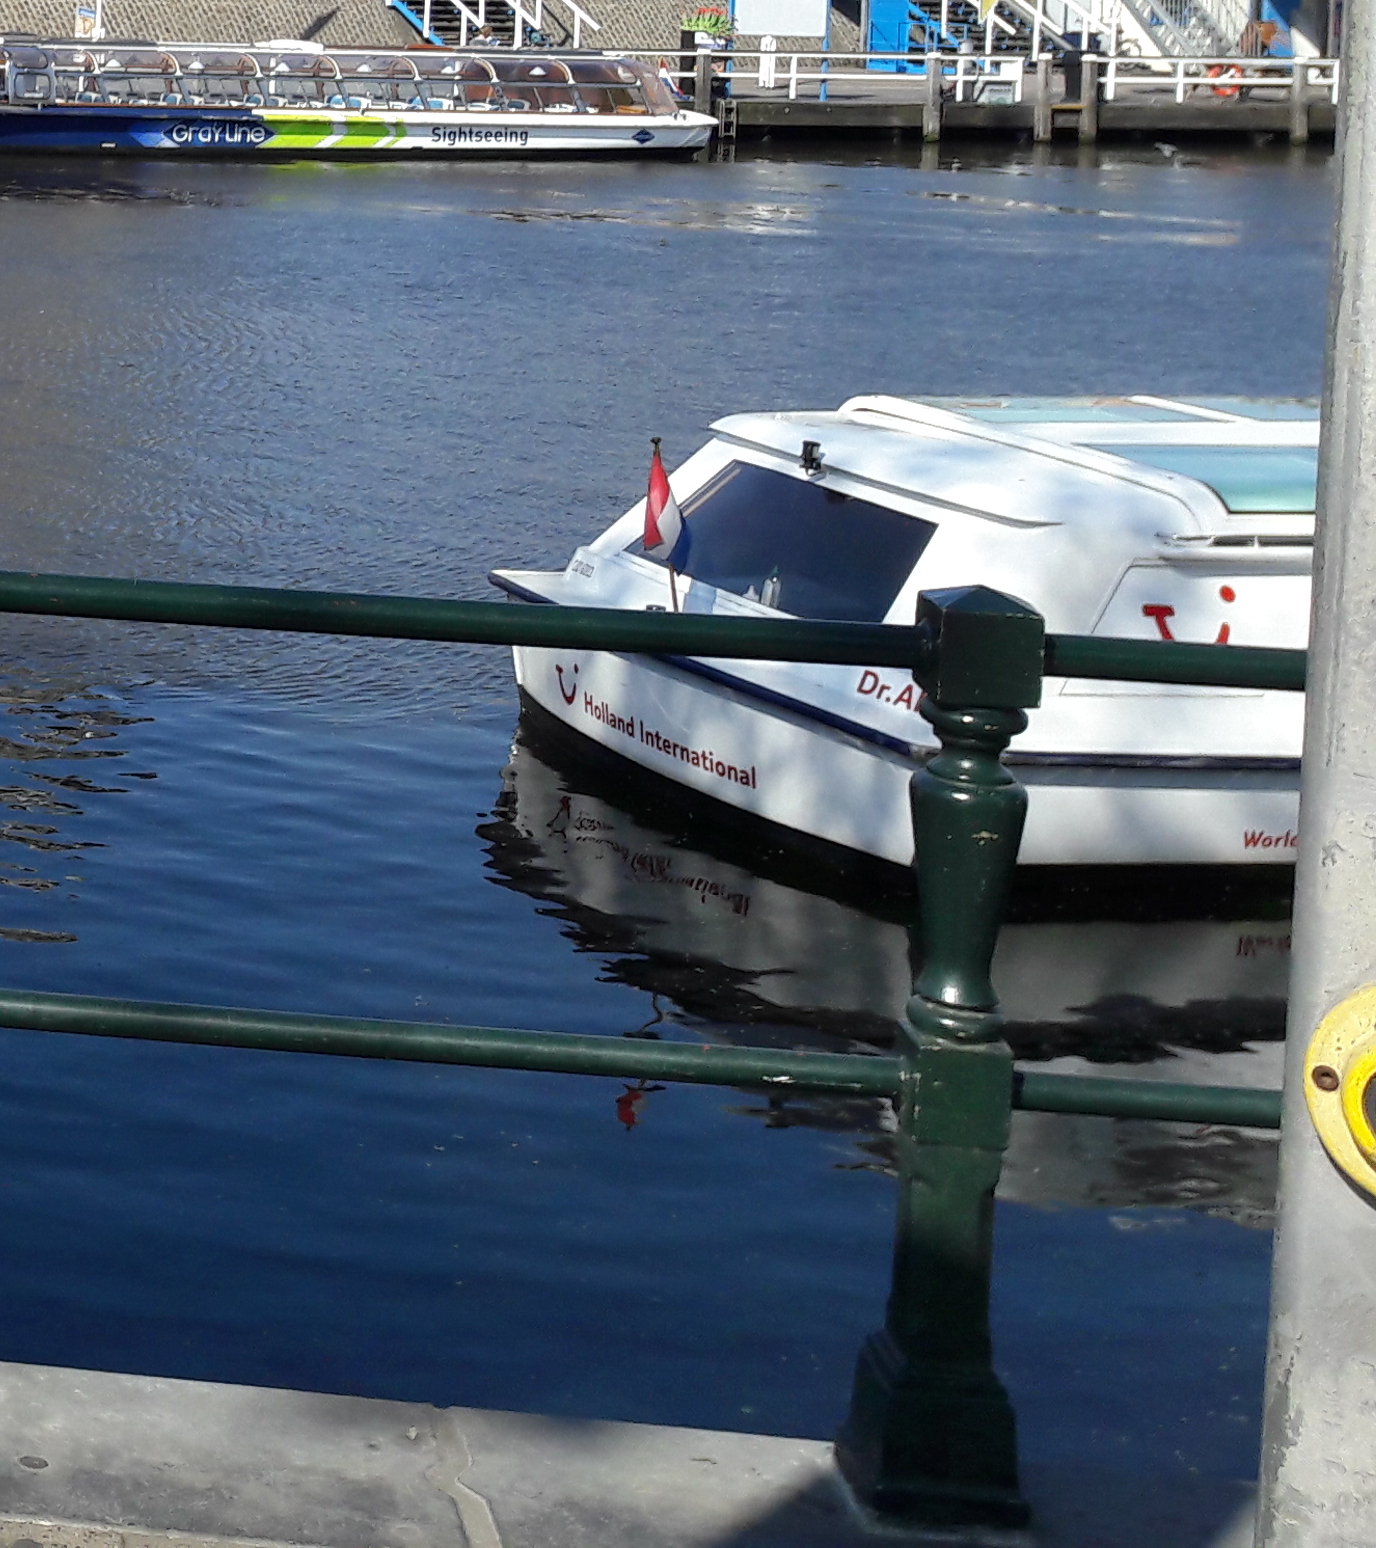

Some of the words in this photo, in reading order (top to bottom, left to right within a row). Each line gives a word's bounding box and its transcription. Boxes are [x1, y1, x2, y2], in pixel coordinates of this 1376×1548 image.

[430, 126, 529, 147] Sightseeing
[584, 691, 635, 738] Holland
[640, 720, 757, 789] International
